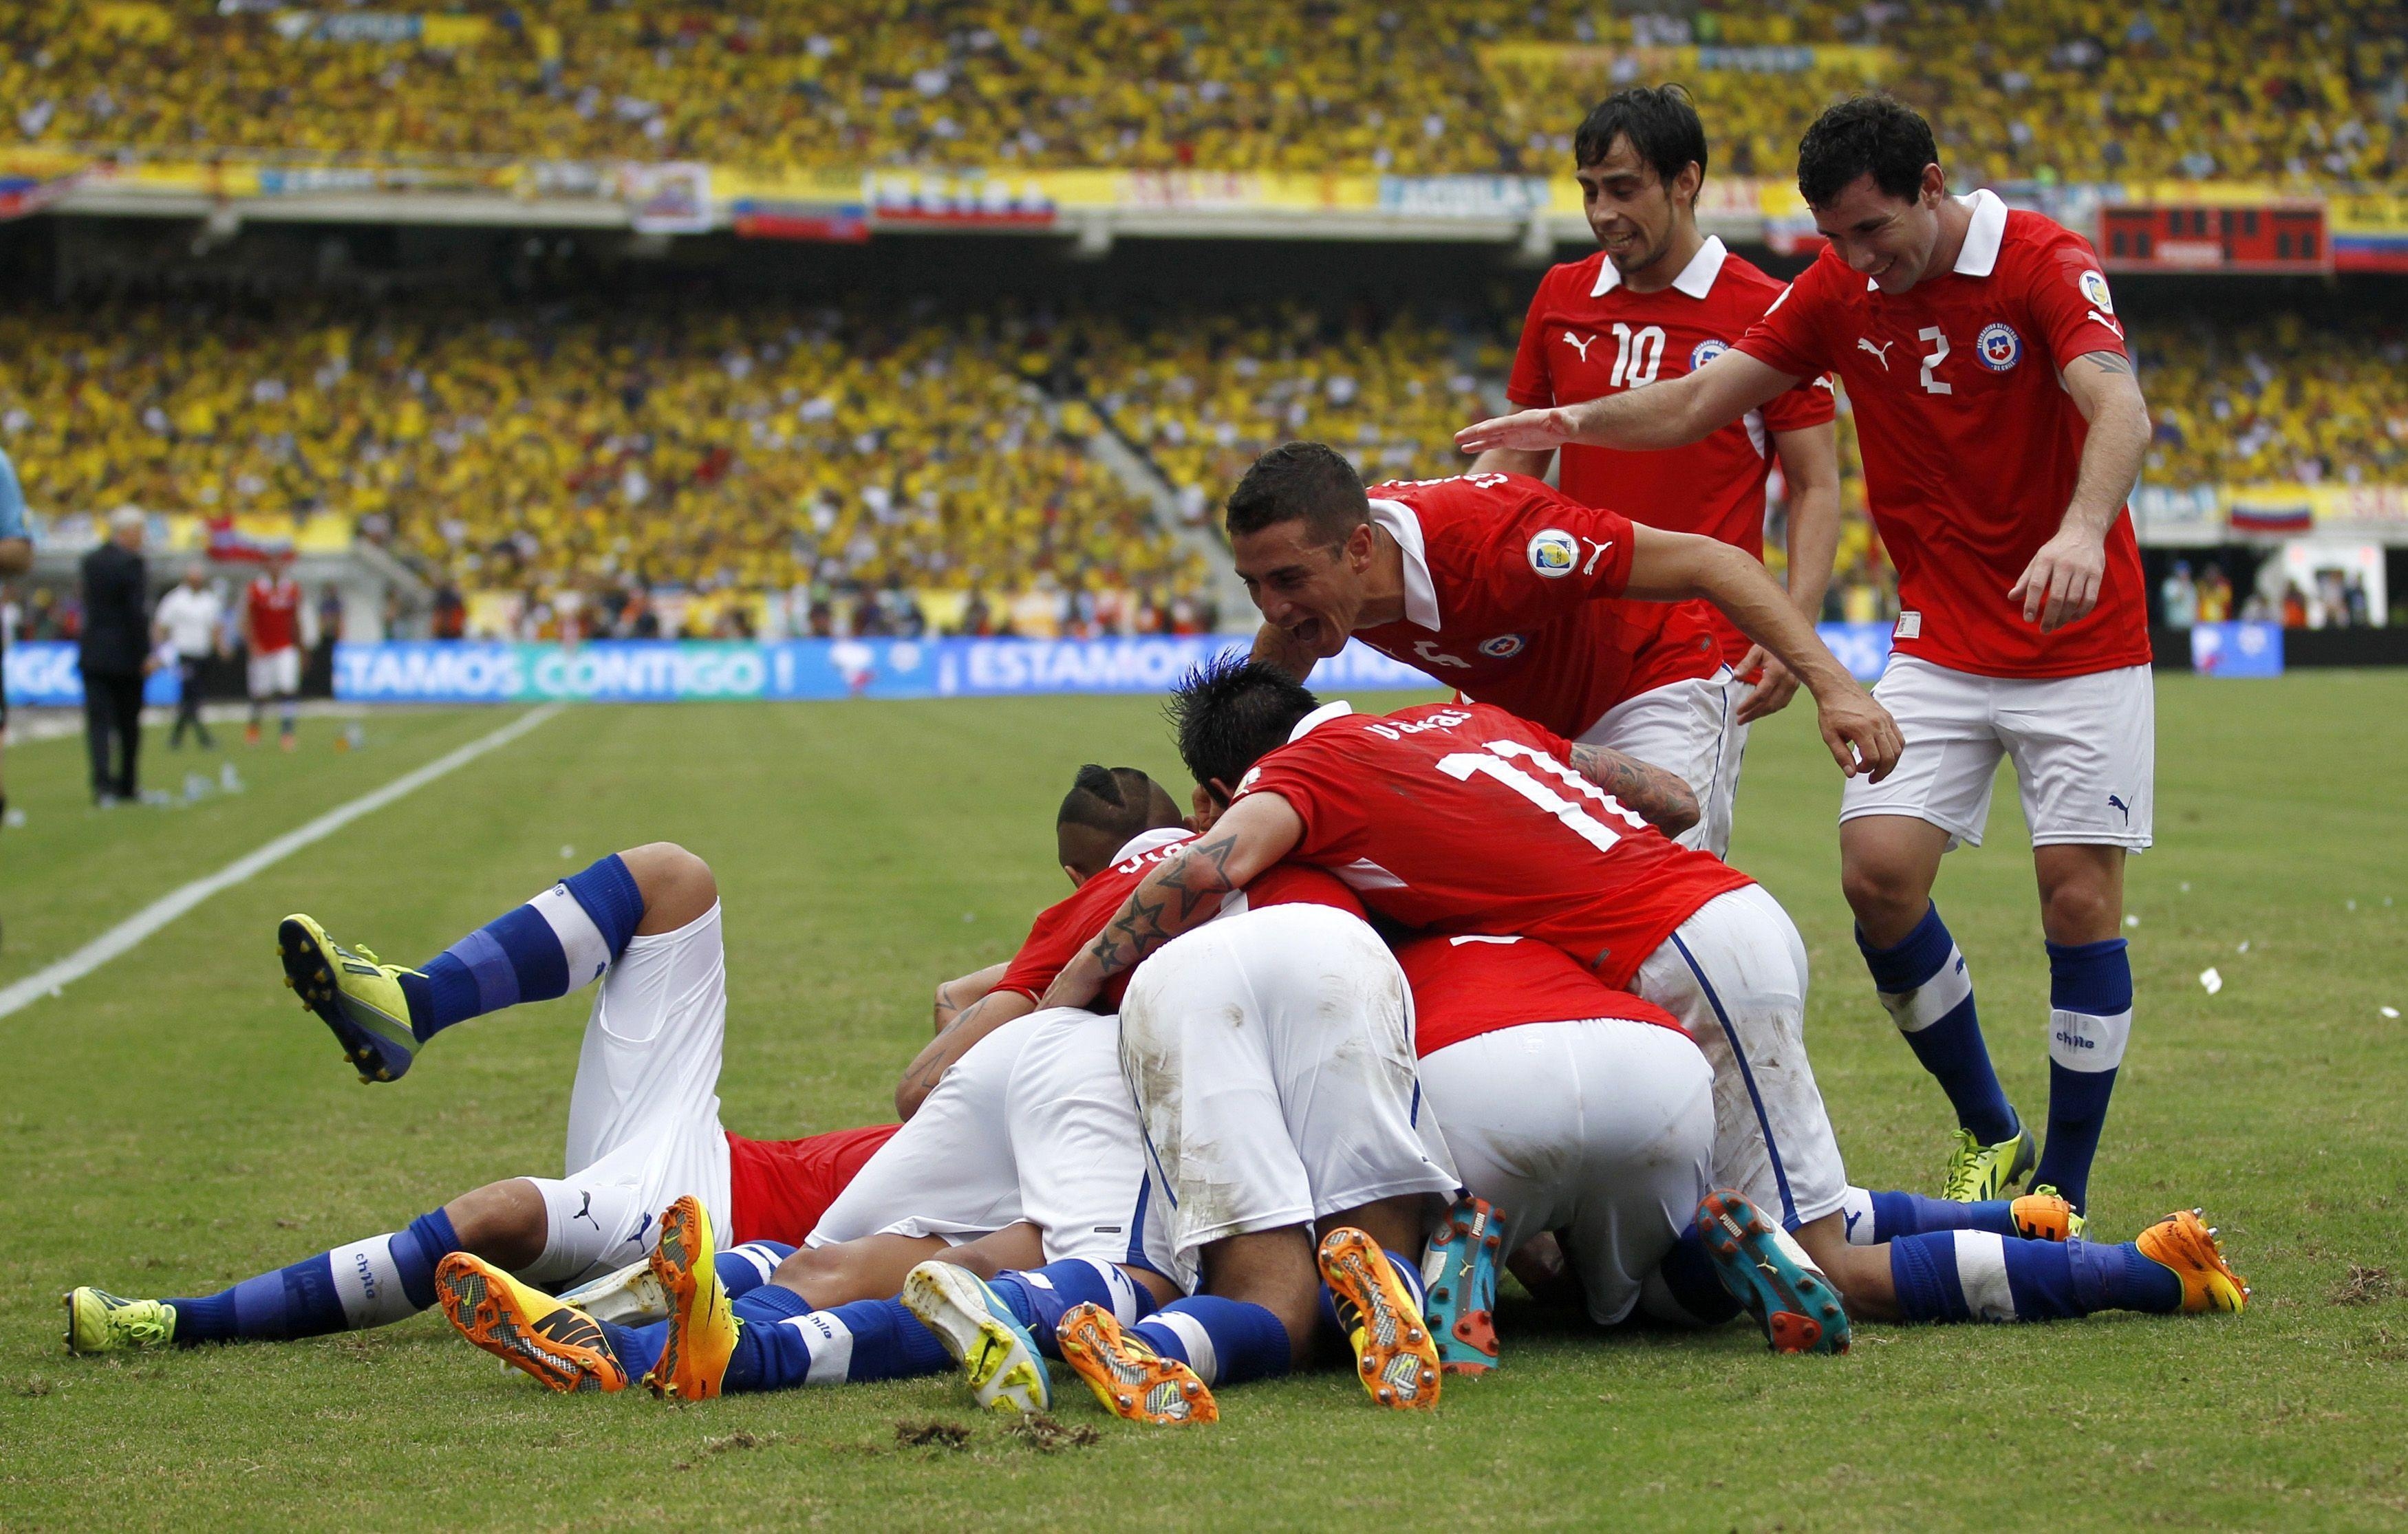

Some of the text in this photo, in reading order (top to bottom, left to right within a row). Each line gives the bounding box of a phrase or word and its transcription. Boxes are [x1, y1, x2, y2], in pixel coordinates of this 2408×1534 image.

[1610, 323, 1666, 388] 10
[1918, 326, 1952, 395] 2
[535, 648, 766, 695] CONTIGO
[1435, 739, 1648, 853] 11
[2056, 1030, 2095, 1049] chile
[1472, 1212, 1486, 1237] PUMA
[1719, 1213, 1743, 1238] PUMA
